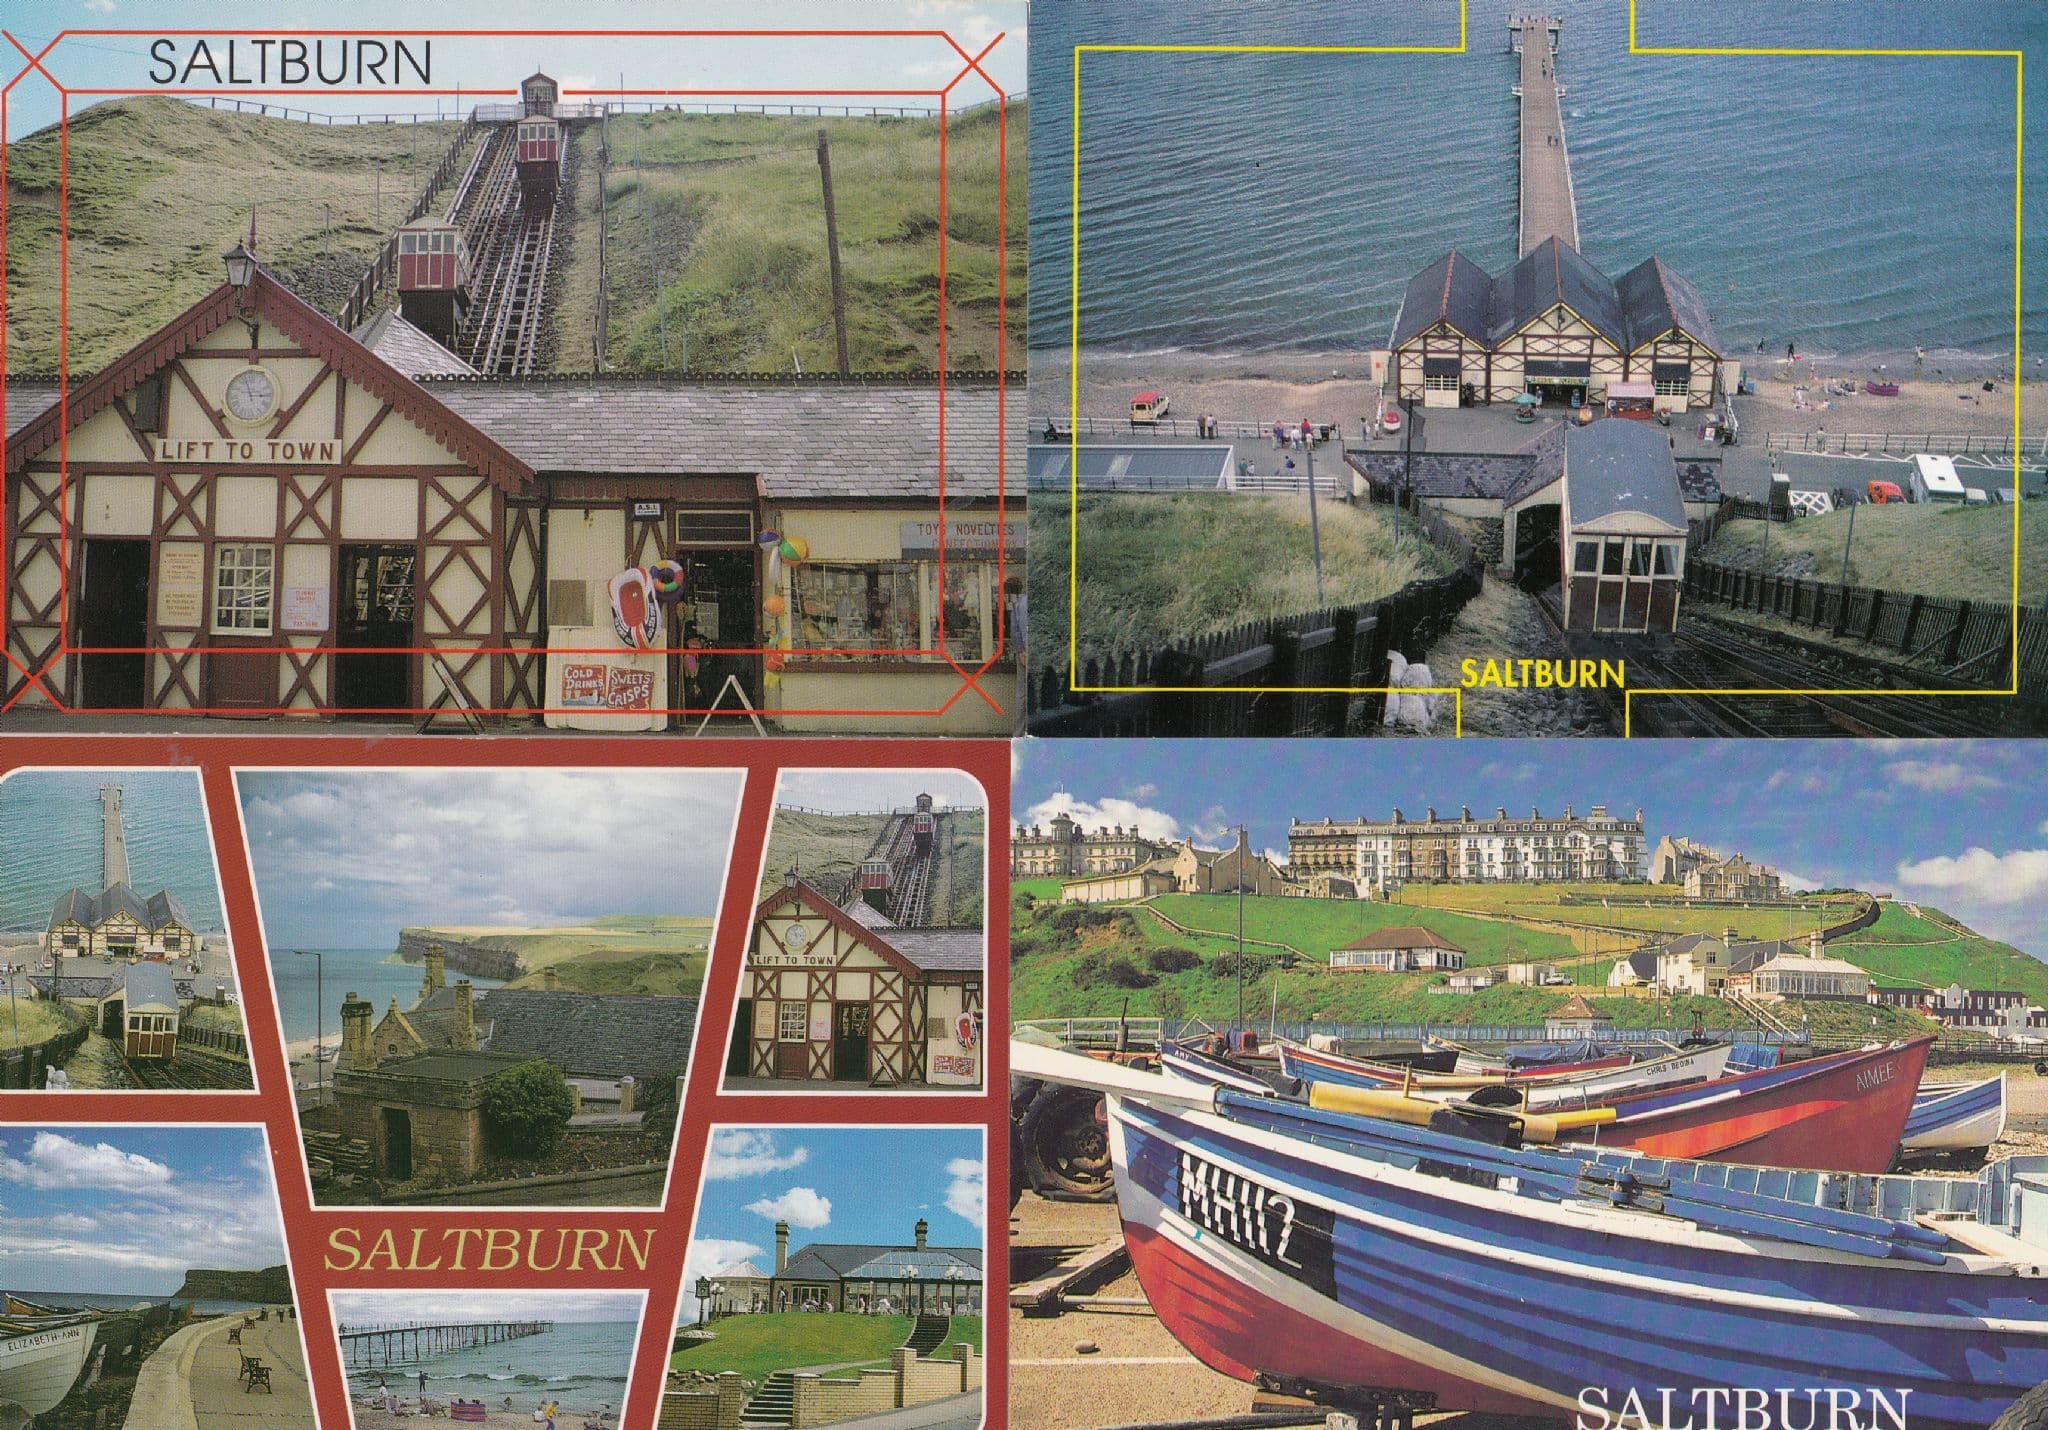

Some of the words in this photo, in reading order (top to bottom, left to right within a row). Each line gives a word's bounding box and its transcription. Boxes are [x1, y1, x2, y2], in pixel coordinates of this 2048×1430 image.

[162, 441, 213, 459] LIFT
[226, 442, 253, 459] TO
[268, 442, 333, 460] TOWN
[565, 666, 593, 679] COLD
[611, 669, 651, 686] SWEETS
[566, 679, 604, 689] DRINKS
[608, 684, 649, 706] CRISPS
[756, 956, 780, 965] LIFT
[785, 956, 798, 965] TO
[804, 956, 833, 965] TOWN
[1856, 1061, 1895, 1092] AIMEE
[1182, 1153, 1302, 1269] MH112
